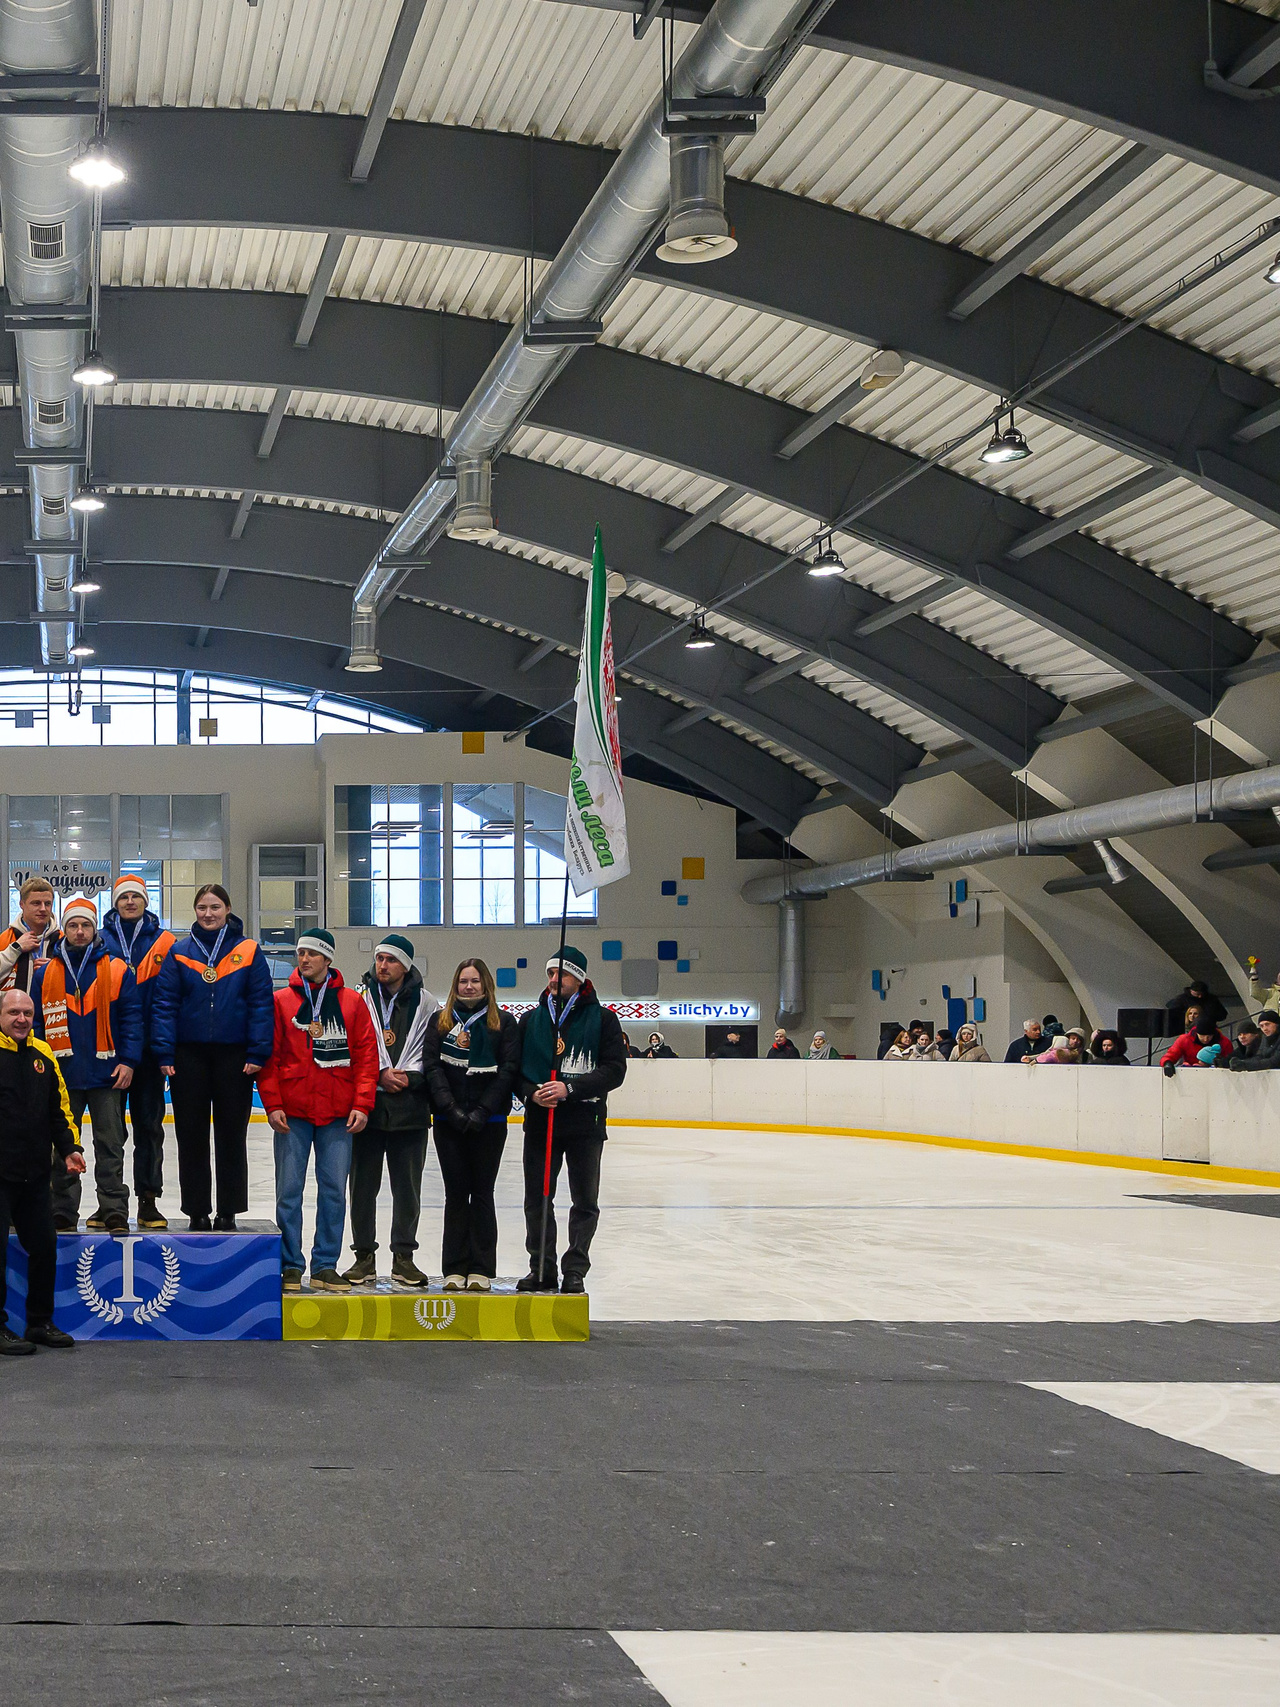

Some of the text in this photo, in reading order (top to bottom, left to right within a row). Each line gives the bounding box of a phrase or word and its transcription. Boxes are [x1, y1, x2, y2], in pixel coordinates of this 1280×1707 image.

[581, 811, 614, 868] леса
[43, 864, 78, 872] КАФЕ
[669, 1003, 750, 1017] silichy.by
[113, 1236, 143, 1302] I
[422, 1299, 449, 1318] III
